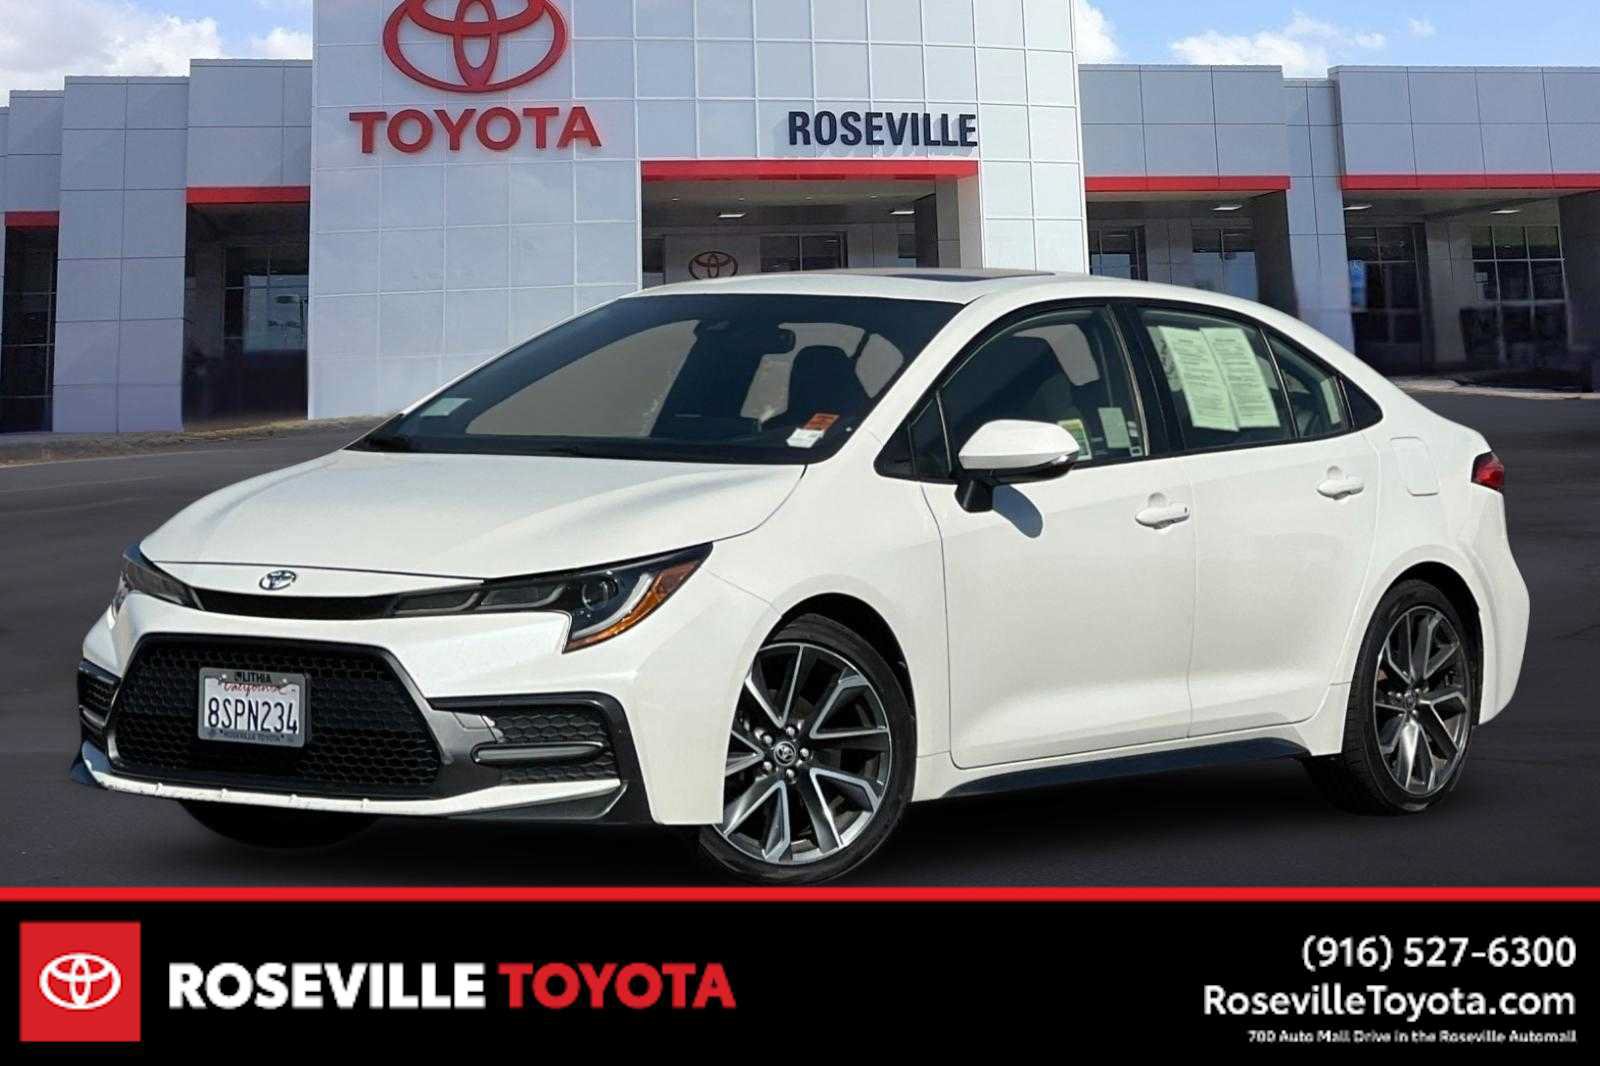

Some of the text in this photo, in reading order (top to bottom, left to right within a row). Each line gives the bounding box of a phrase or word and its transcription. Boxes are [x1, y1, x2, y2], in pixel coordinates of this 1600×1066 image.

[349, 105, 602, 154] TOYOTA
[788, 111, 978, 147] ROSEVILLE
[242, 671, 272, 684] LITHIA
[208, 697, 298, 735] 8SPN234
